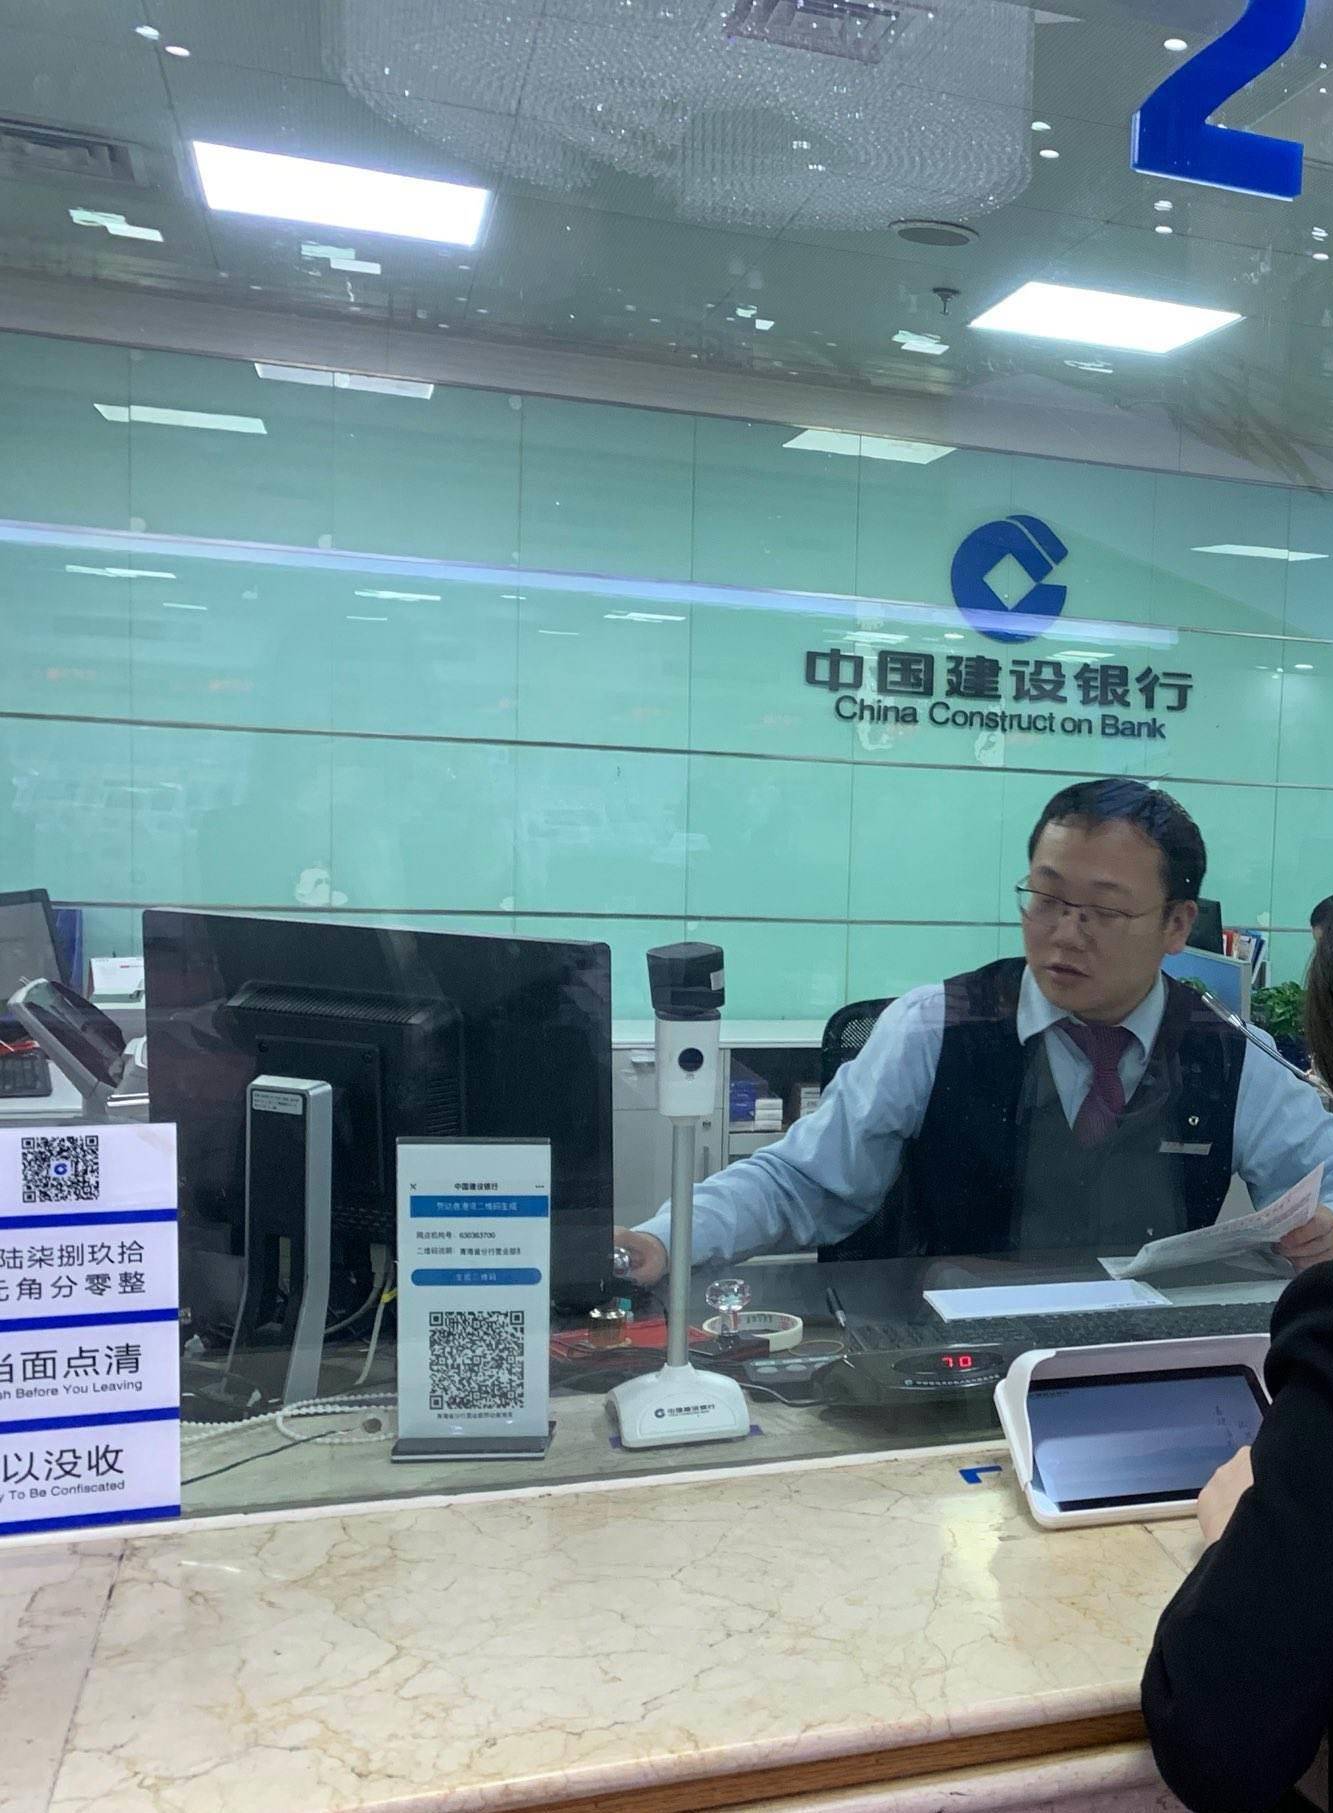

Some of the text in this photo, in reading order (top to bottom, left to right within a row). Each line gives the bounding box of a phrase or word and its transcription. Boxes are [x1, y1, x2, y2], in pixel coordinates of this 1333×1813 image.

[805, 648, 1194, 714] 中国建设银行
[835, 695, 918, 726] China
[1101, 714, 1166, 739] Bank
[0, 1240, 145, 1270] 陆柒捌玖拾
[15, 1386, 59, 1399] Before
[63, 1384, 89, 1395] You
[93, 1380, 143, 1393] Leaving
[3, 1444, 125, 1484] 以没收
[8, 1490, 26, 1501] To
[29, 1487, 48, 1499] Be
[50, 1480, 126, 1497] Confiscated
